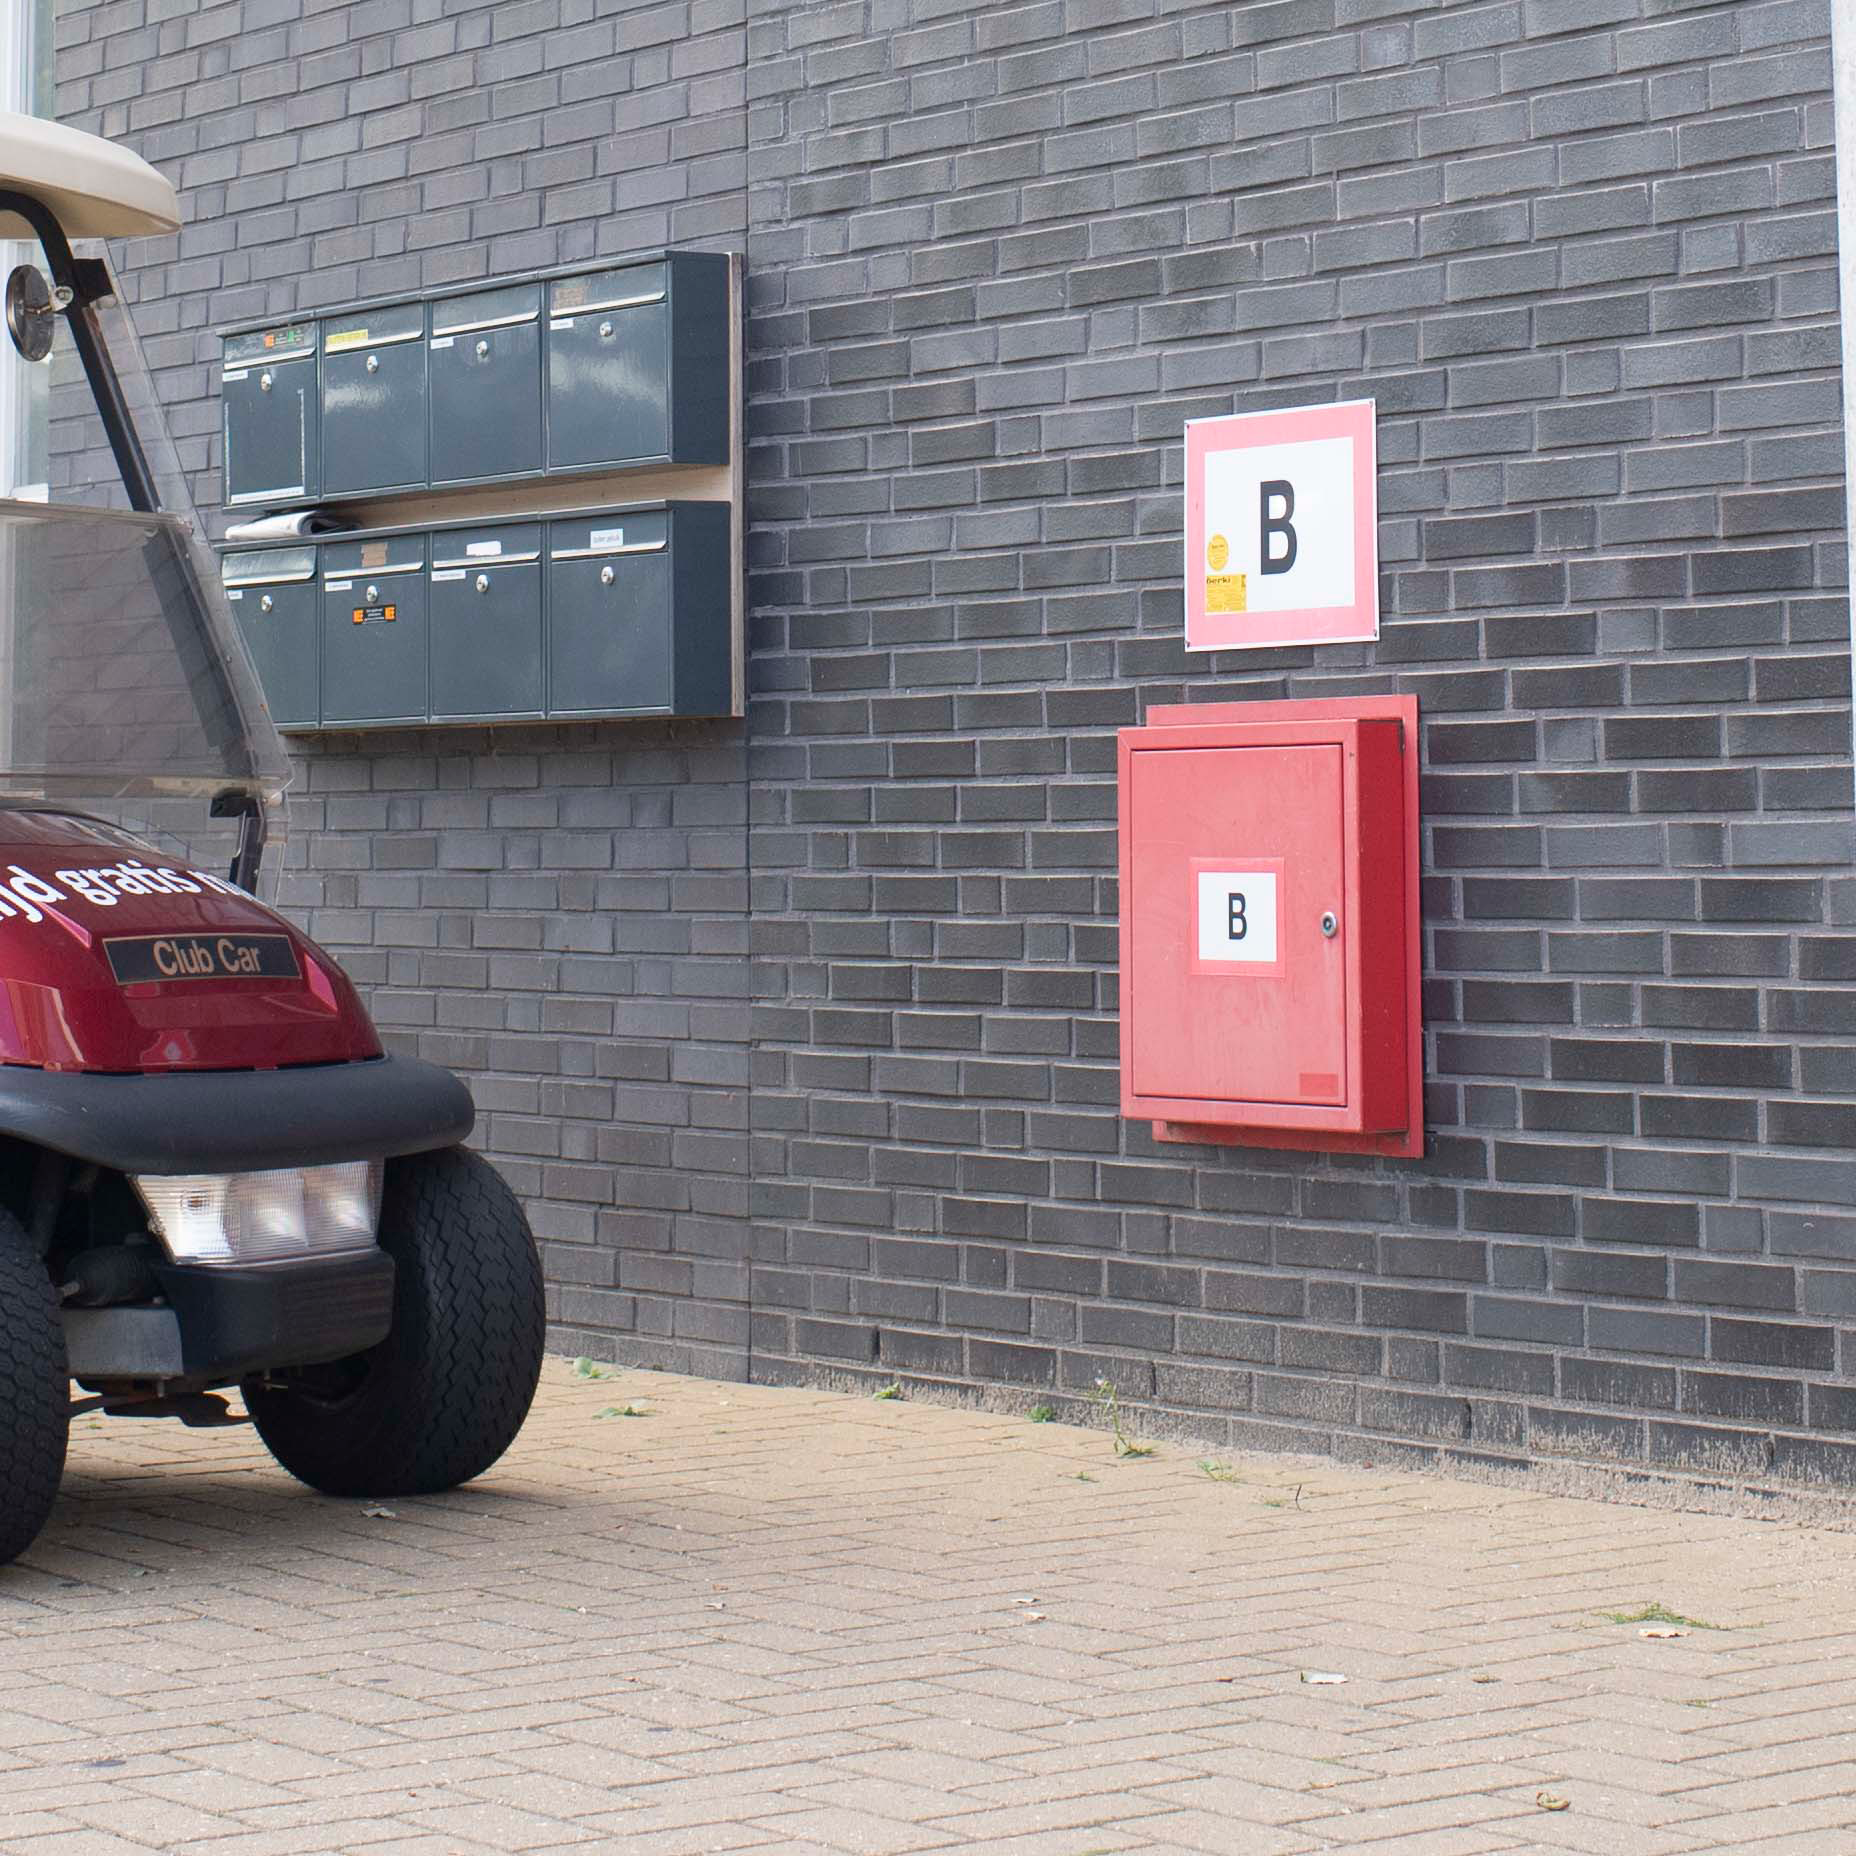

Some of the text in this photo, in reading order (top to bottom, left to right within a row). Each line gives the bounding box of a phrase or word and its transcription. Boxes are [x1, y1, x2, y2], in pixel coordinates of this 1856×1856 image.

[1260, 479, 1297, 575] B
[55, 859, 202, 907] gratis
[1228, 892, 1248, 940] B
[152, 938, 262, 977] Club Car
